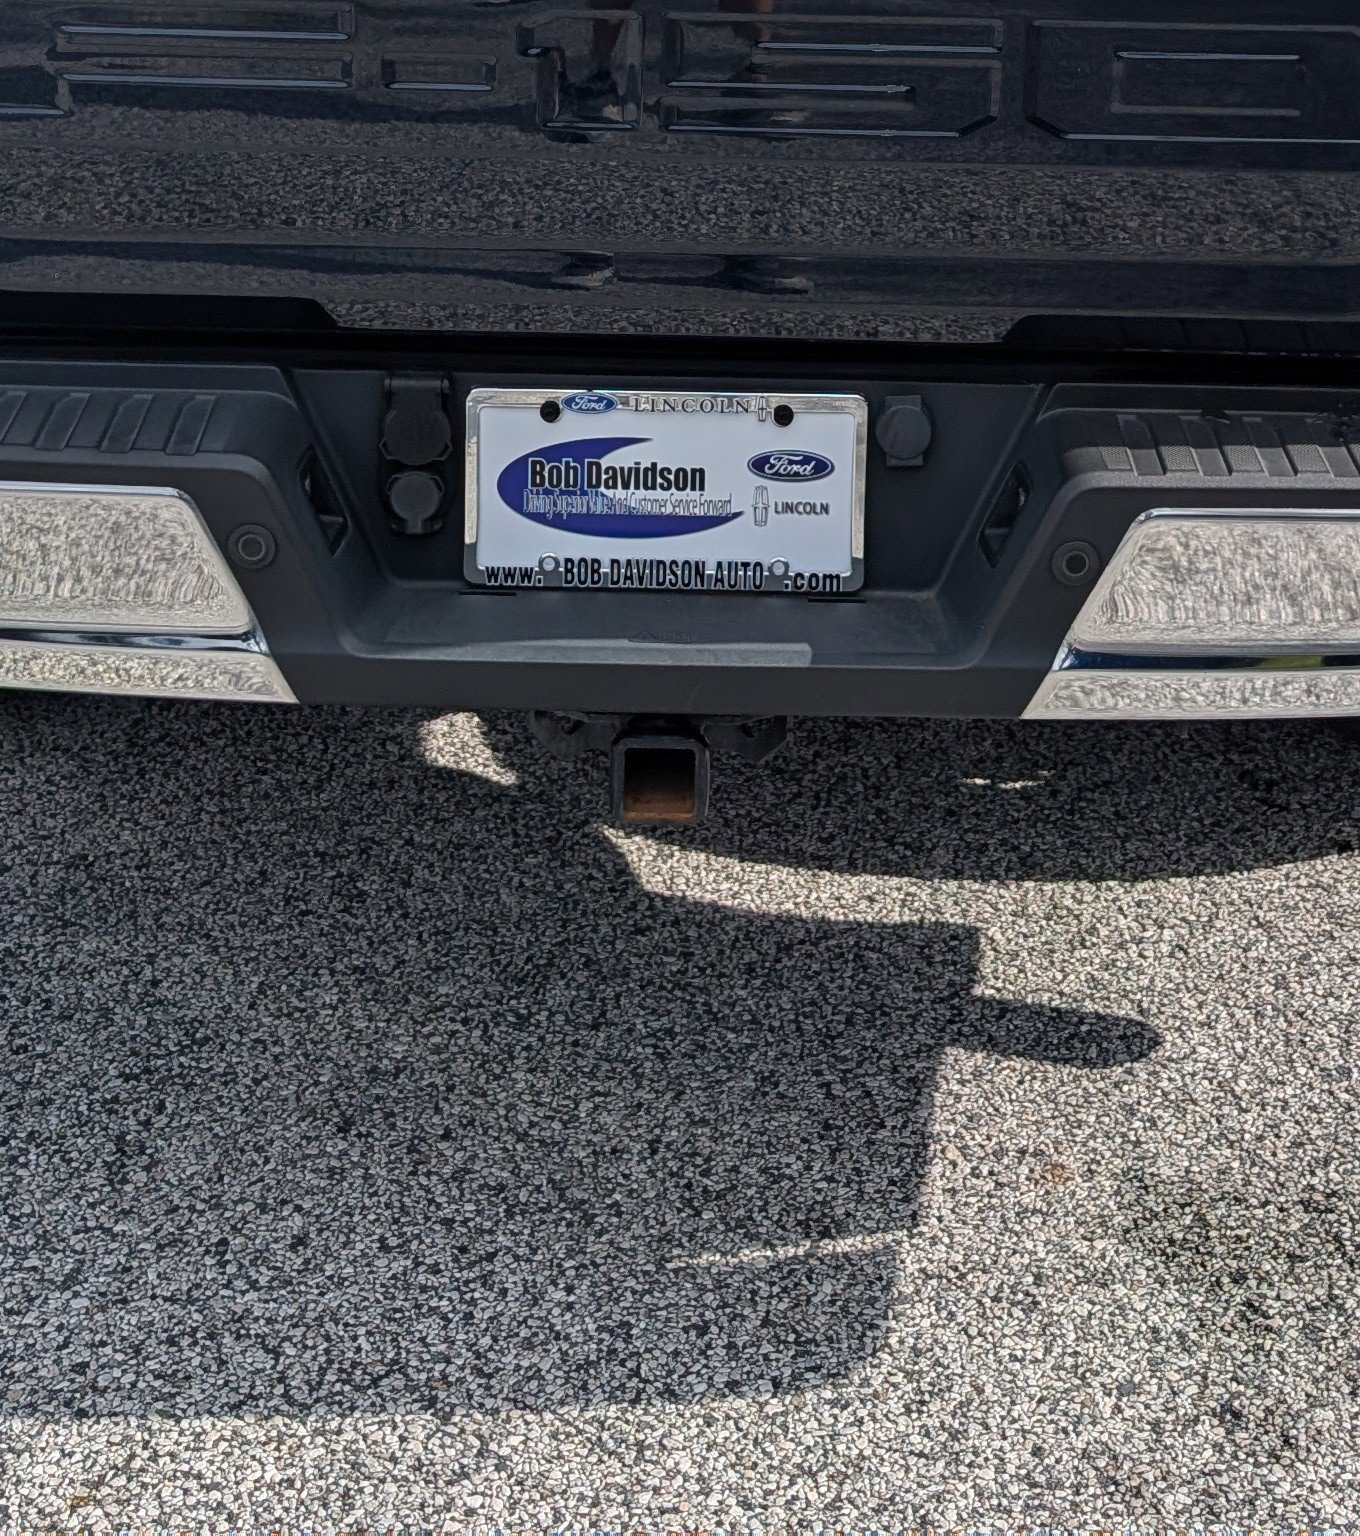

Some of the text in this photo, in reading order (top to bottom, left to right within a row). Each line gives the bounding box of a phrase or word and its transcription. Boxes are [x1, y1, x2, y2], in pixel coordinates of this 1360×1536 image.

[571, 395, 606, 411] Ford
[634, 396, 751, 414] LINCOLN
[529, 458, 706, 492] Bob Davidson
[764, 454, 817, 475] Ford
[523, 489, 554, 520] Driving
[554, 489, 589, 520] Superior
[629, 492, 669, 516] Customer
[669, 492, 697, 516] Service
[699, 492, 733, 517] Forward
[774, 501, 830, 515] LINCOLN
[563, 557, 602, 587] BOB
[609, 558, 706, 589] DAVIDSON
[713, 561, 764, 590] AUTO
